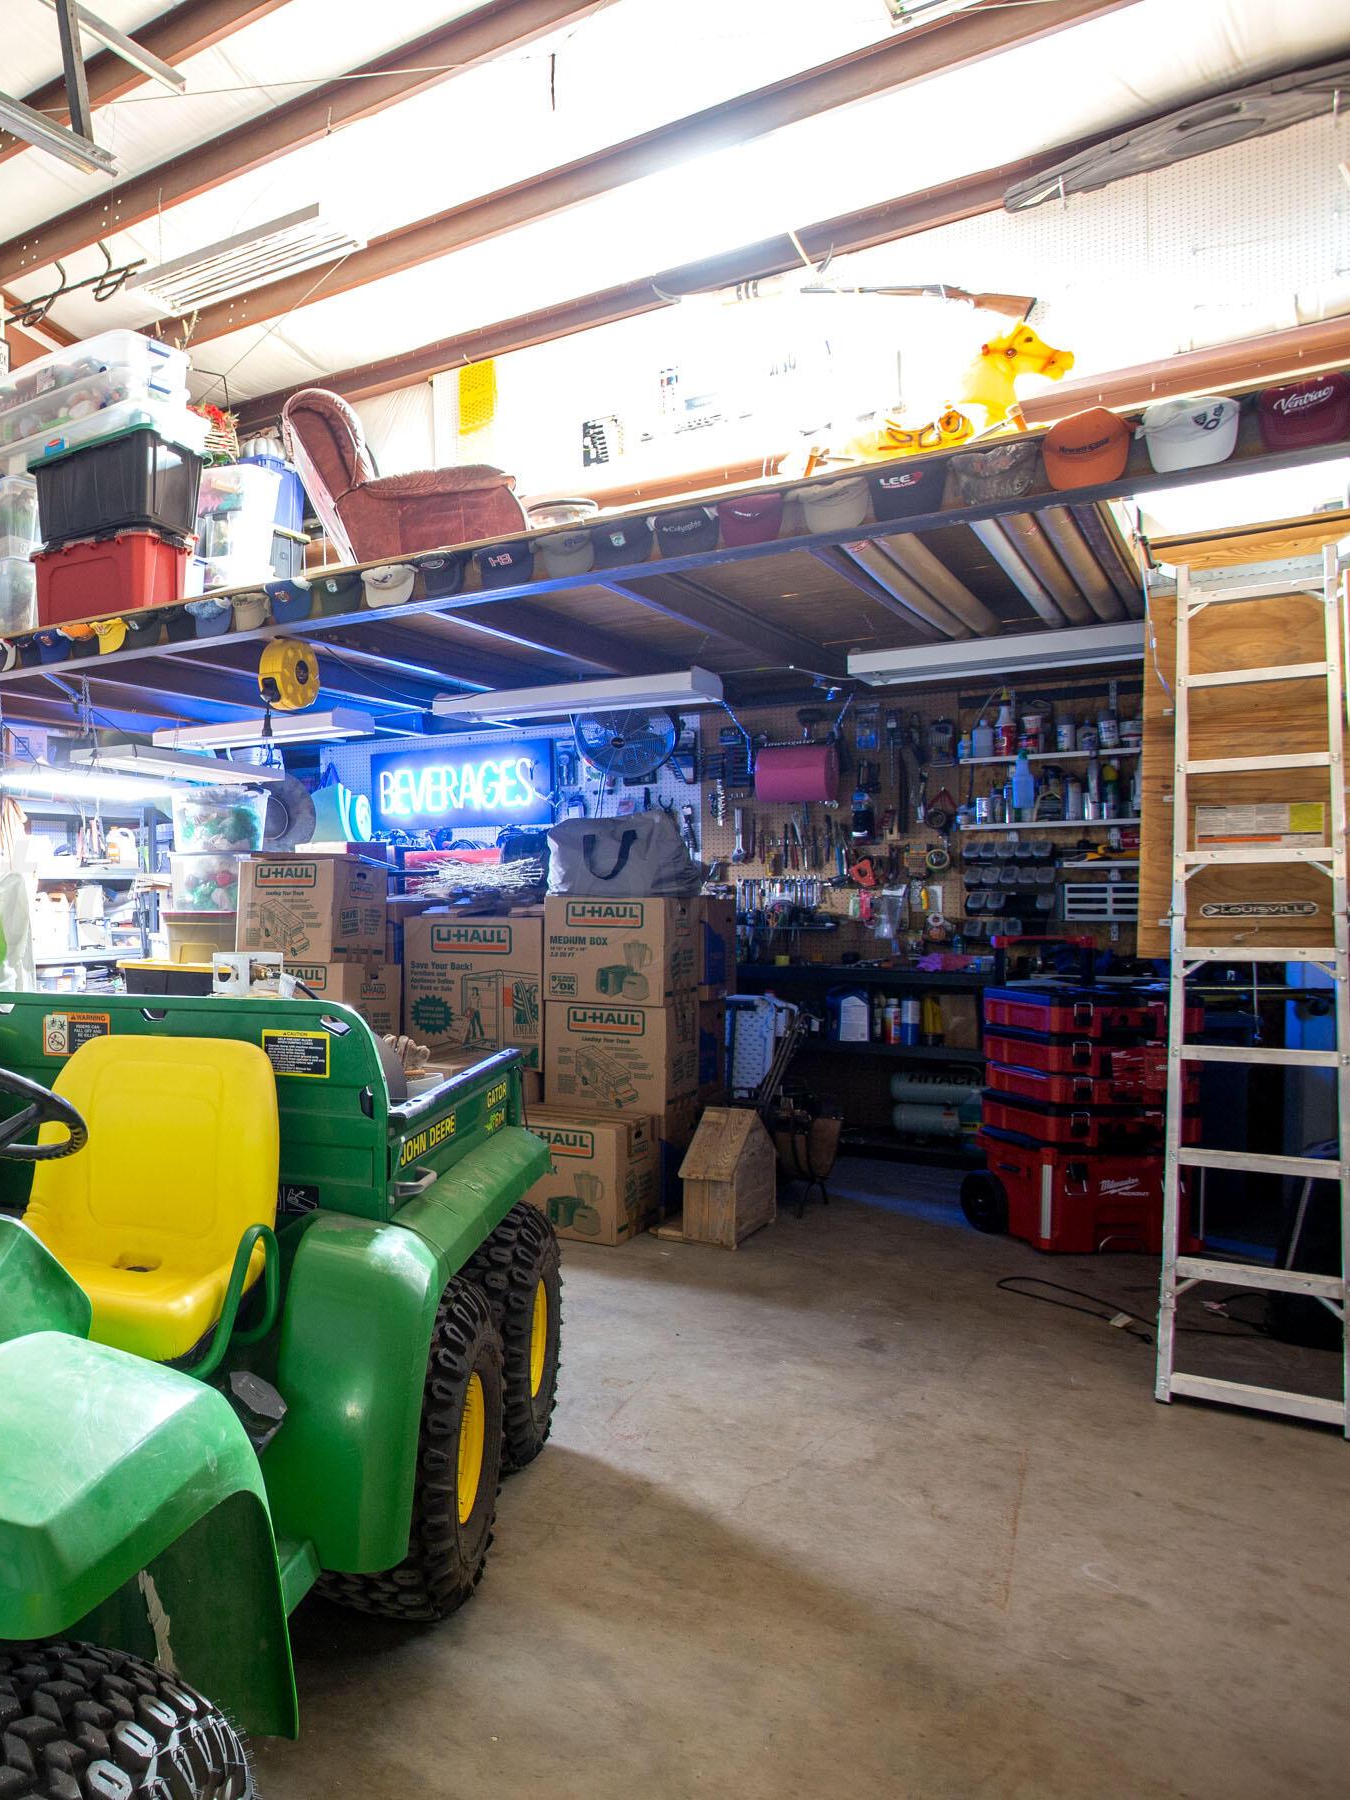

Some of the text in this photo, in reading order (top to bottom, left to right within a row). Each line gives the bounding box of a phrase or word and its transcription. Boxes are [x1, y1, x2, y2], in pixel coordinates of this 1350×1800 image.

[1273, 386, 1334, 412] Ventrac
[879, 474, 911, 486] LEE
[380, 757, 533, 816] BEVERAGES
[259, 867, 313, 879] U-HAUL
[571, 906, 639, 918] U-HAUL
[1221, 905, 1315, 915] LOUISVILLE
[436, 928, 507, 943] U-HAUL
[550, 935, 608, 946] MEDIUM BOX
[410, 961, 473, 971] Save Your Back!
[559, 983, 576, 991] OK
[573, 1011, 640, 1026] U-HAUL
[487, 1082, 507, 1108] GATOR
[401, 1115, 455, 1167] JOHN DEERE
[1100, 1176, 1140, 1190] Milwaukee
